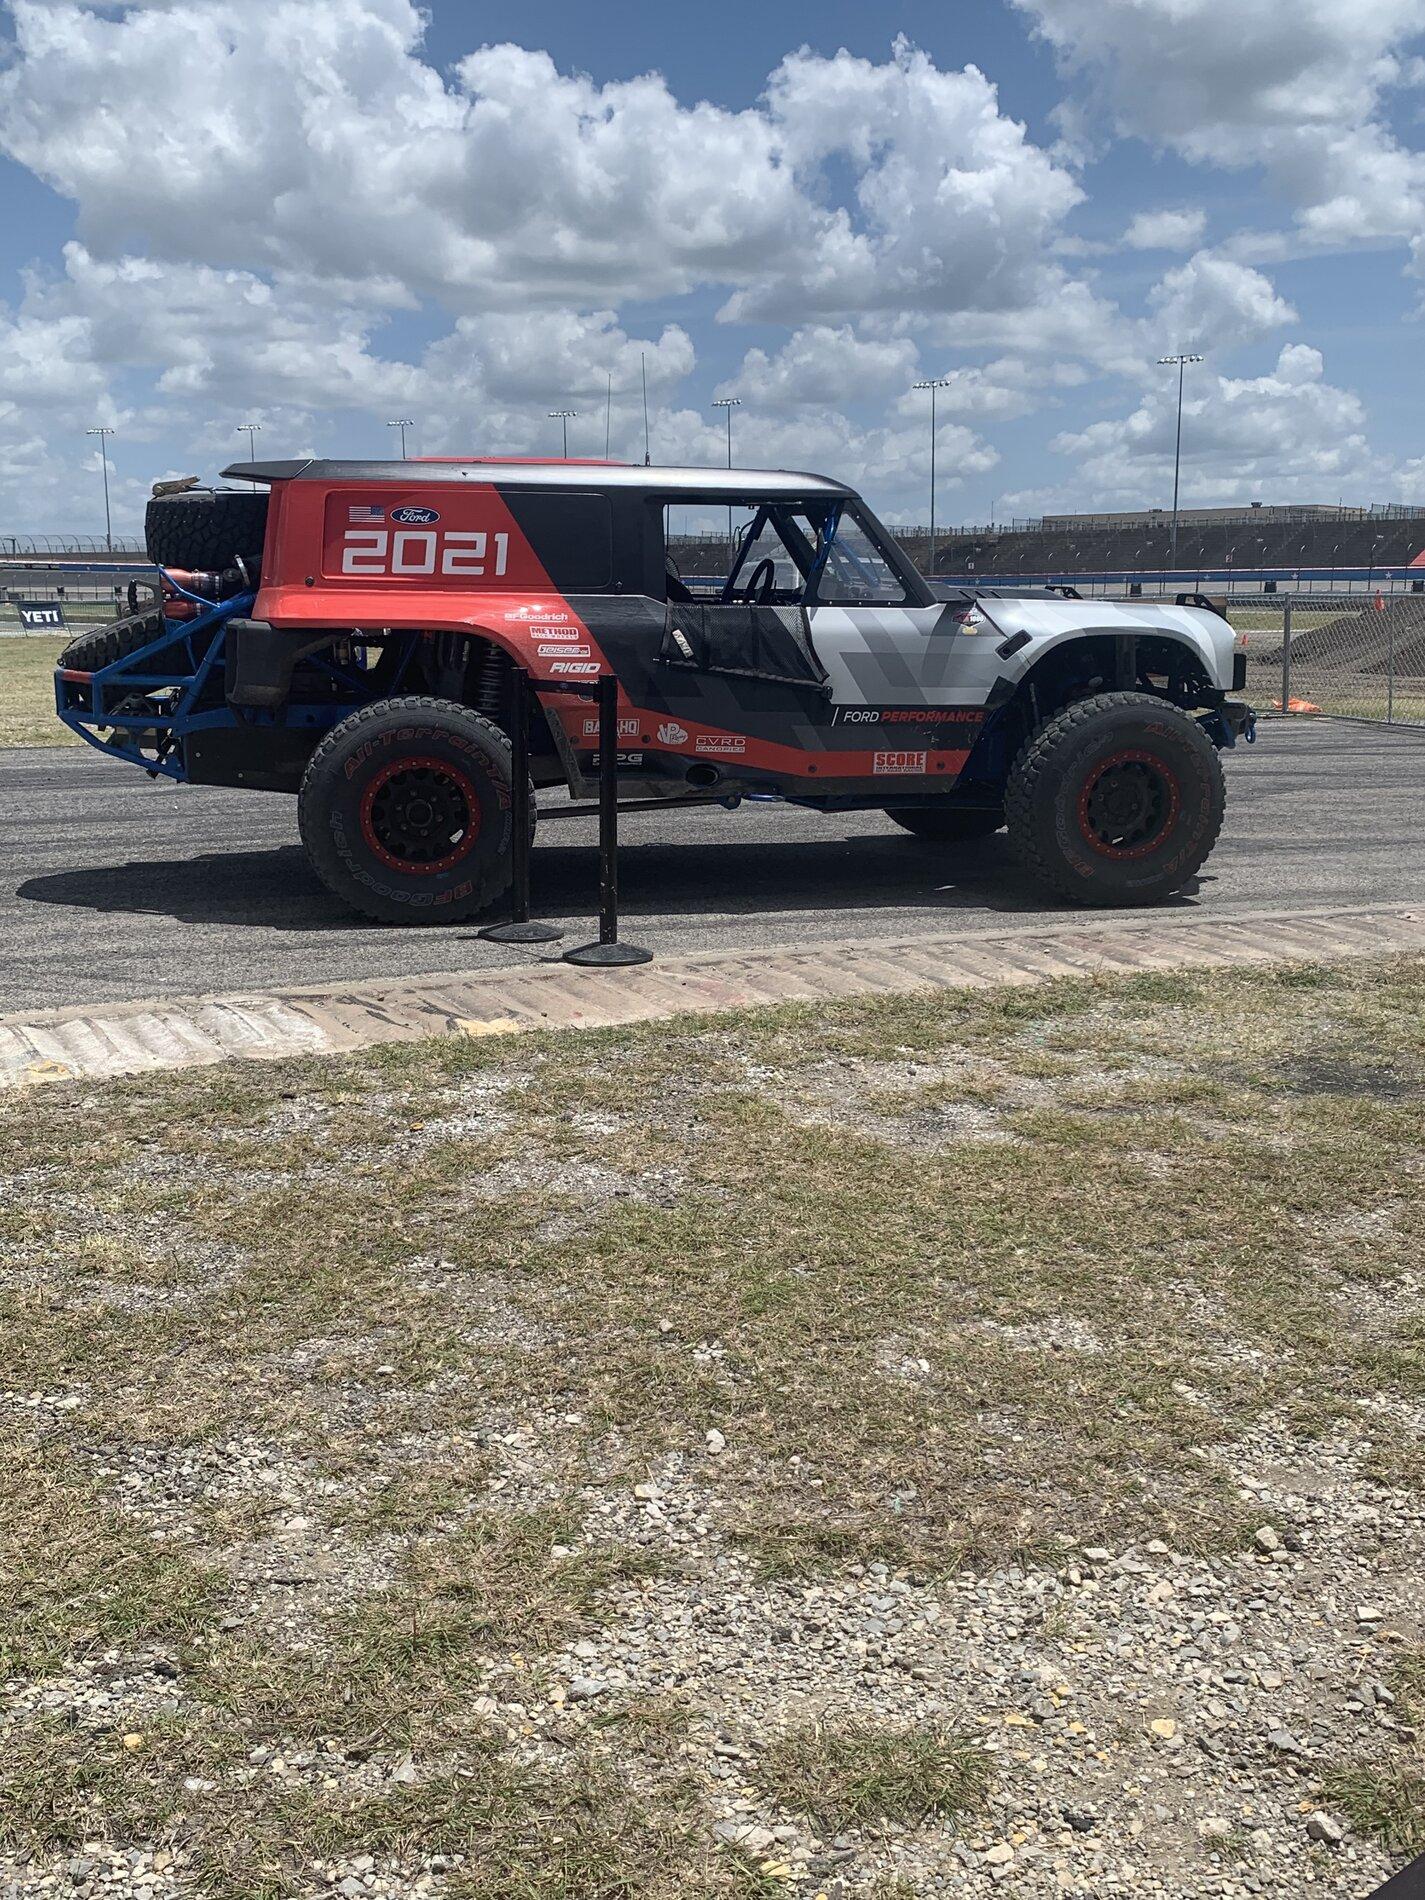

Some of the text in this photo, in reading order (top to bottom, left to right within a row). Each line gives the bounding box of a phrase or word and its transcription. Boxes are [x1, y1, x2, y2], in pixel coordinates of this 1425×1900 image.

[400, 508, 430, 523] Ford
[342, 530, 509, 576] 2021
[21, 610, 59, 622] YETI
[532, 627, 577, 635] METHOD
[550, 662, 601, 673] RIGID
[843, 711, 985, 722] FORD PERFORMANCE
[876, 752, 924, 765] SCORE
